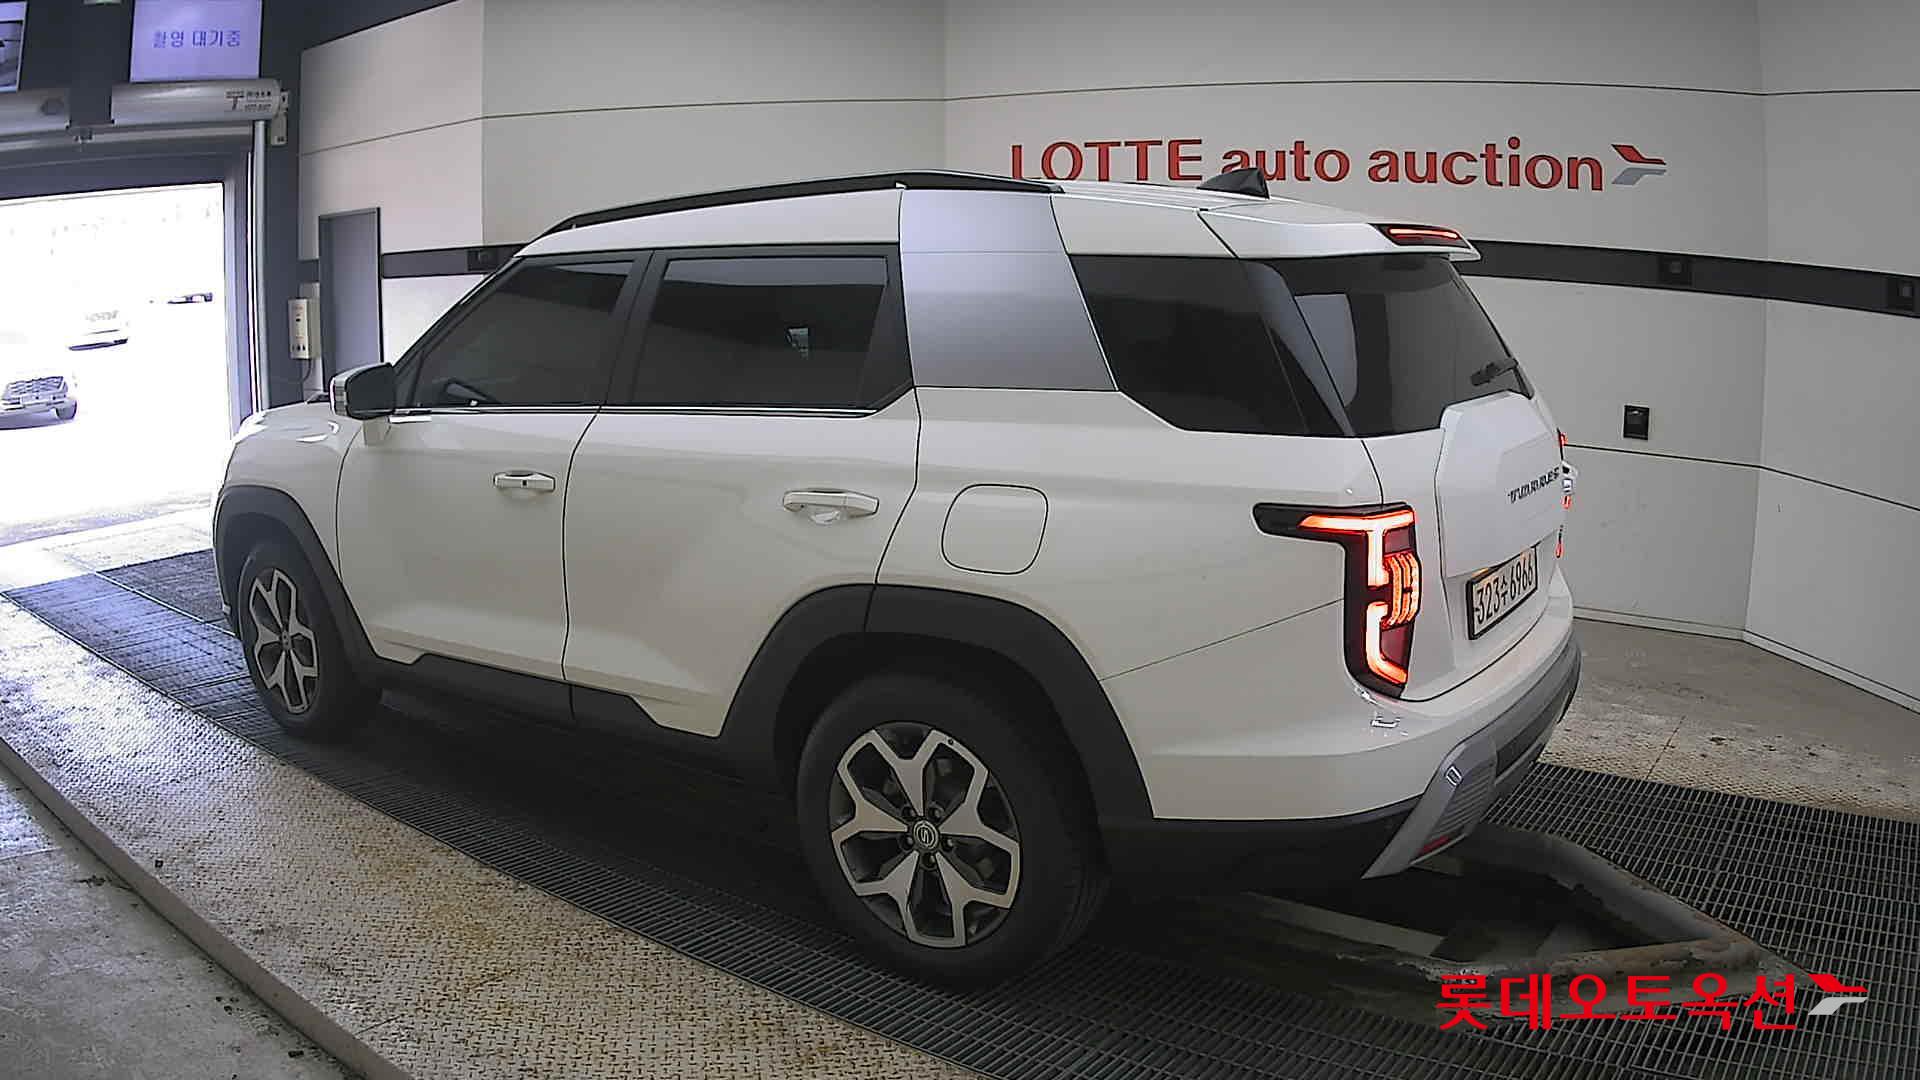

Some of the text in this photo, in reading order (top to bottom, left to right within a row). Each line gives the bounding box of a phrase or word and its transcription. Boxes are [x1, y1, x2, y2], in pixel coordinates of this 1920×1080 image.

[192, 30, 240, 47] 대기중
[1011, 136, 1603, 191] LOTTE auto auction
